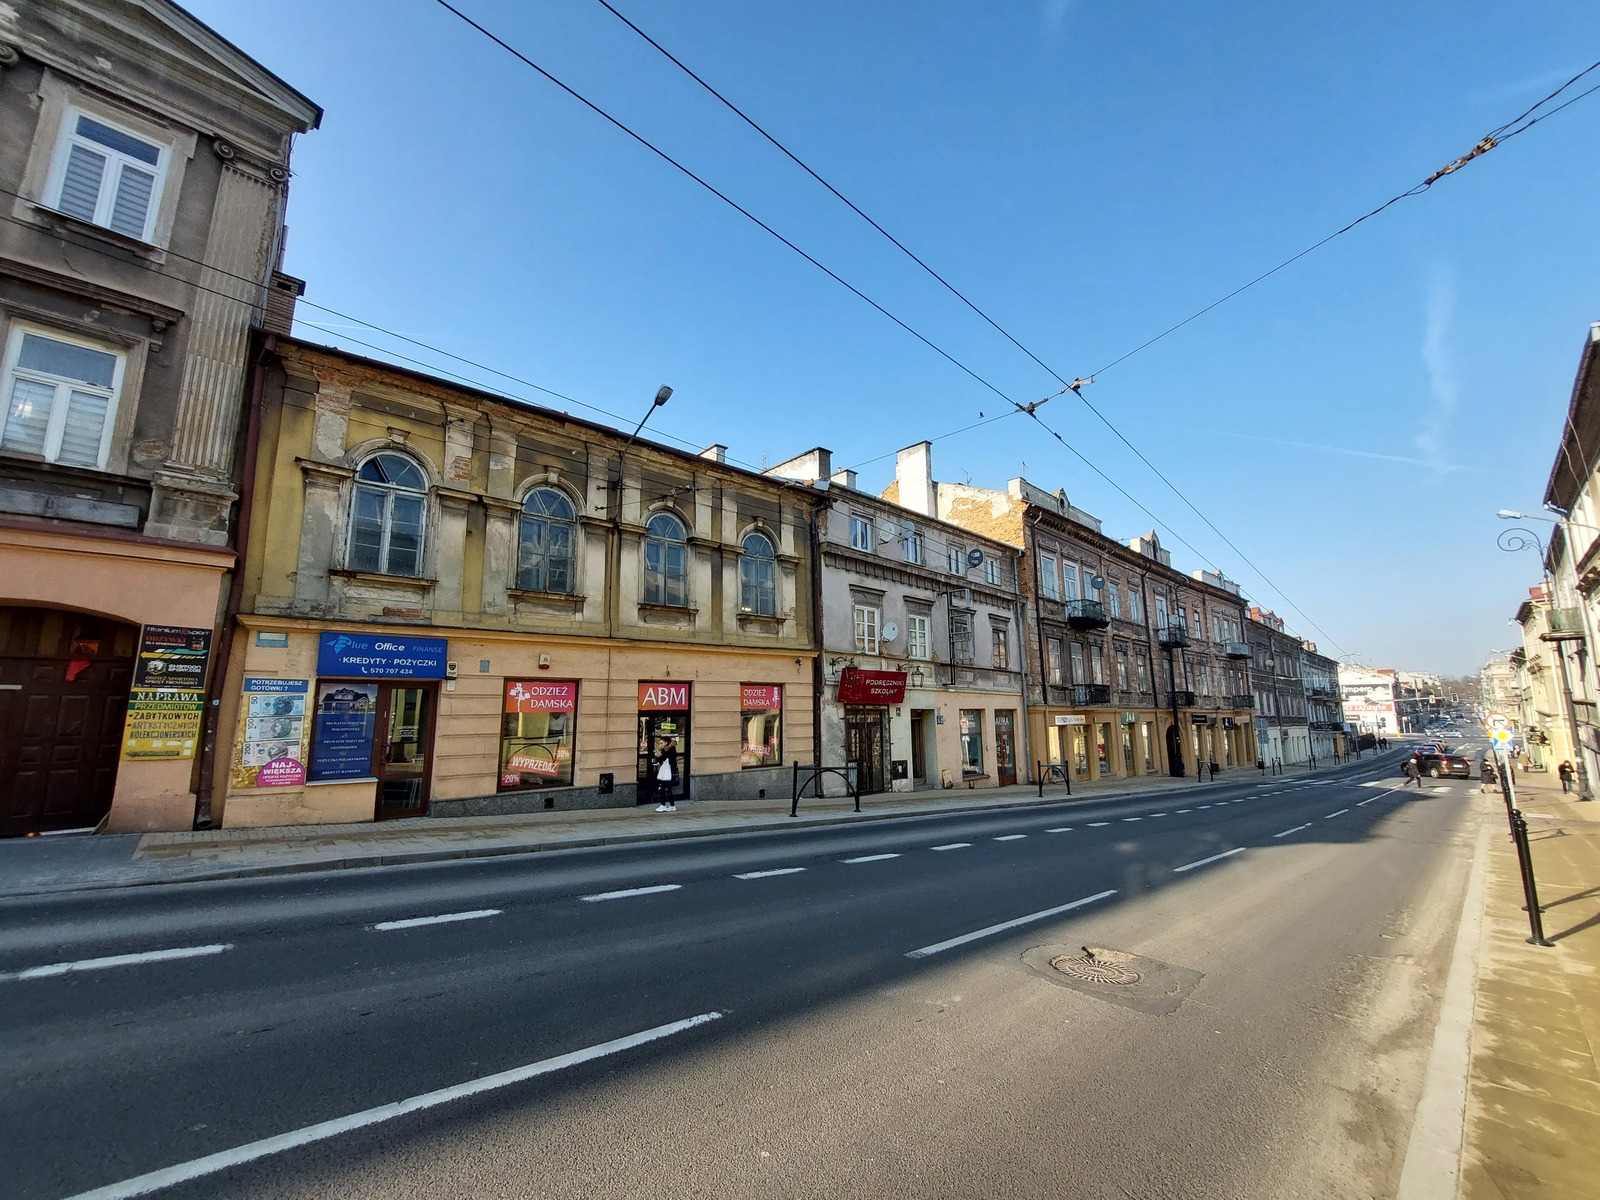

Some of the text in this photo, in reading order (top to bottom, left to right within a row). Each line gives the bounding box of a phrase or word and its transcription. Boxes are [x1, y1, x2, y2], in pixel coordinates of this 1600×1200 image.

[374, 642, 405, 652] Office
[412, 645, 443, 653] FINANSE
[342, 656, 437, 666] KREDYTY POŻYCZKI
[865, 679, 905, 687] PODRĘCZNIKI
[531, 686, 568, 696] ODZIEŻ
[743, 688, 767, 697] ODZIEŻ
[136, 692, 199, 701] NAPRAWA
[642, 687, 685, 706] ABM
[530, 699, 574, 708] DAMSKA
[743, 698, 771, 706] DAMSKA
[133, 712, 199, 720] ZABYTKOWYCH
[132, 721, 198, 729] ARTYSTYCZNYCH
[271, 761, 296, 769] NAJ-
[511, 756, 558, 773] WYPRZEDAŻ
[502, 774, 520, 783] -20%
